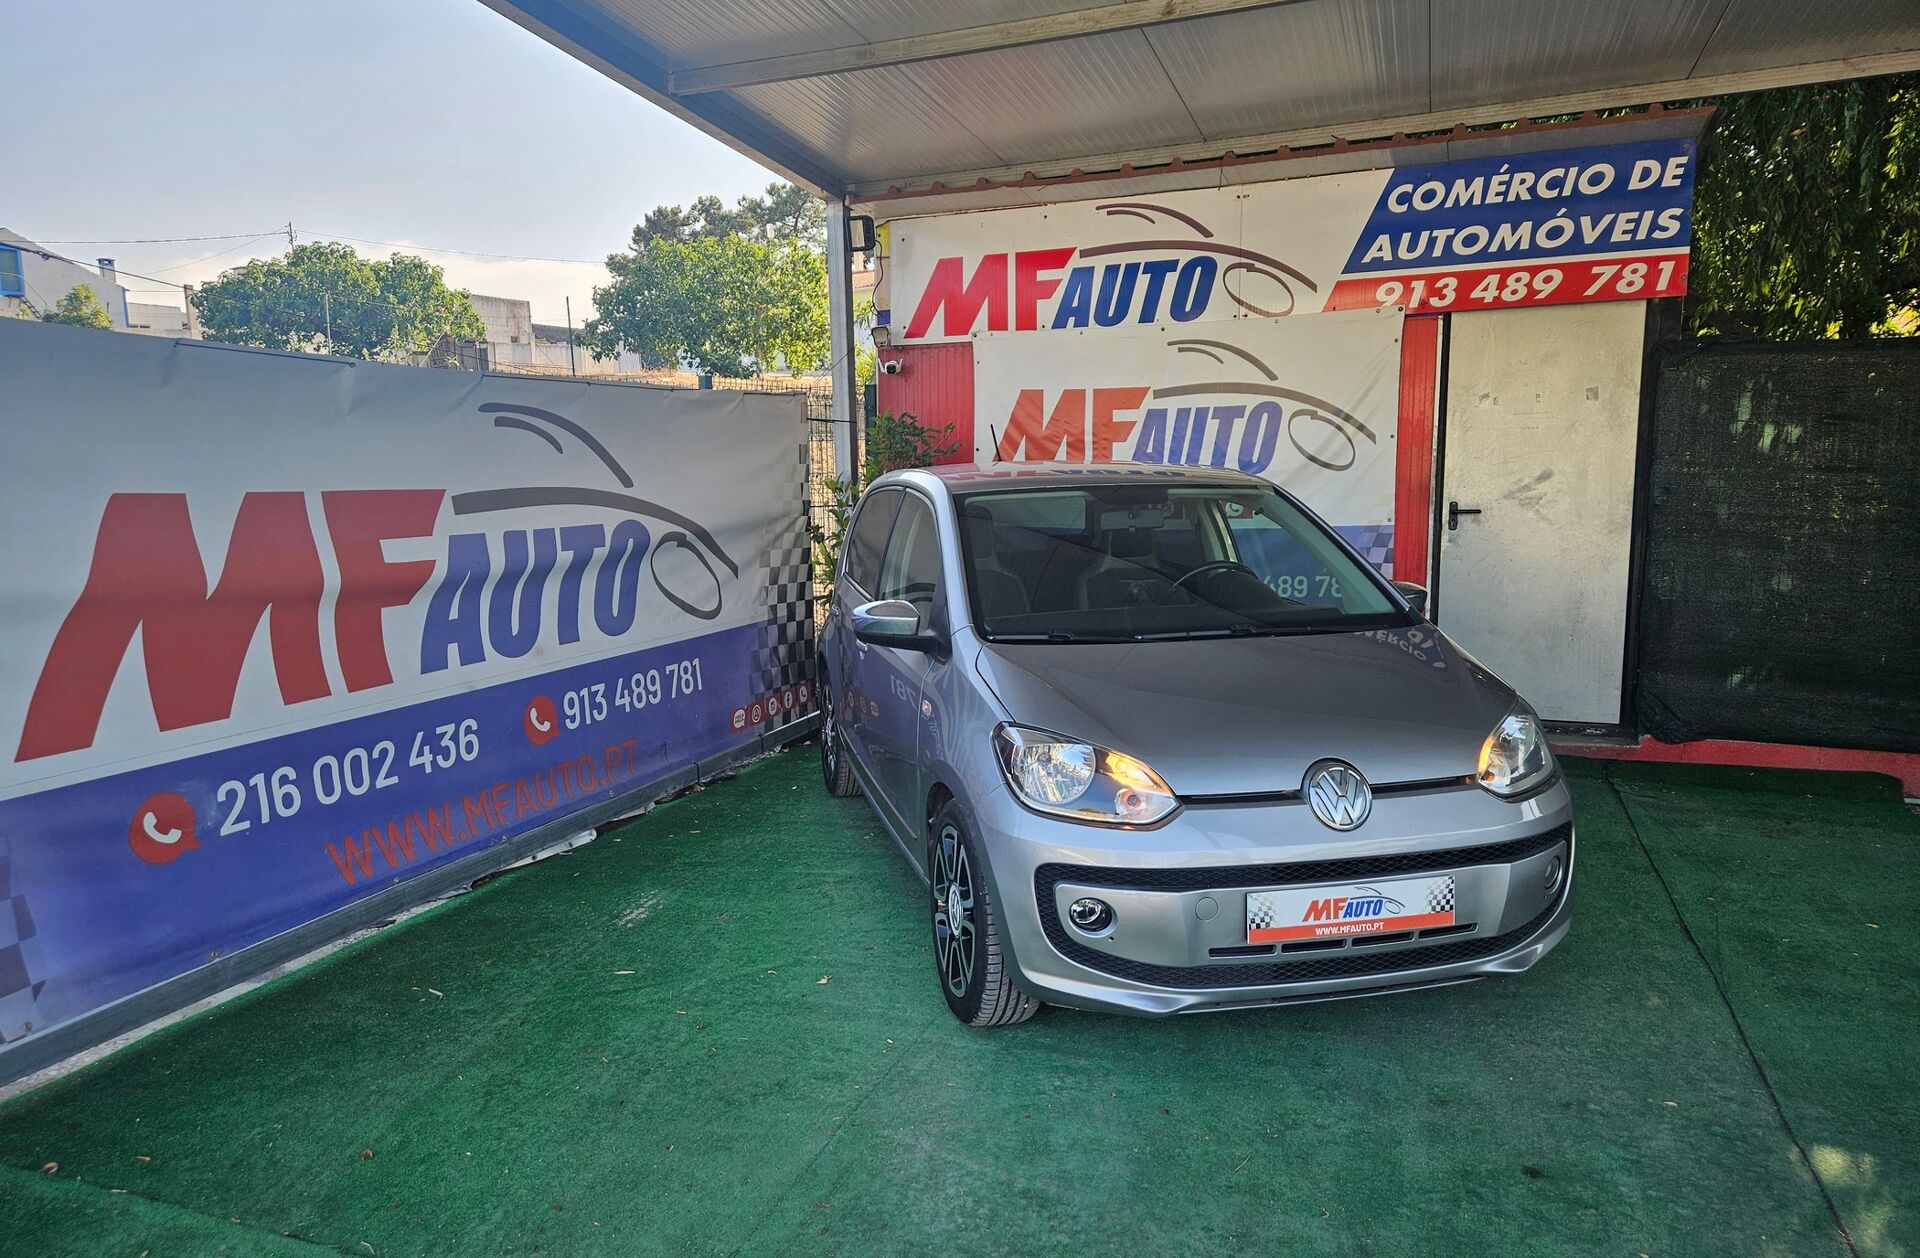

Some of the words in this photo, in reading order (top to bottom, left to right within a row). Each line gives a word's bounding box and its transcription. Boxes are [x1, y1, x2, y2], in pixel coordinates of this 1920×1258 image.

[1387, 163, 1615, 214] COMÉRCIO
[1627, 156, 1689, 190] DE
[1361, 207, 1684, 263] AUTOMÓVEIS
[1375, 276, 1458, 309] 913
[1470, 269, 1563, 302] 489
[1583, 261, 1675, 296] 781
[563, 683, 607, 730] 913
[614, 669, 662, 712] 489
[665, 657, 703, 700] 781
[217, 766, 301, 837] 216
[312, 740, 399, 805] 002
[409, 718, 480, 774] 436
[326, 738, 640, 887] WWW.MFAUTO.PT
[1315, 922, 1385, 936] WWW.MFAUTO.PT
